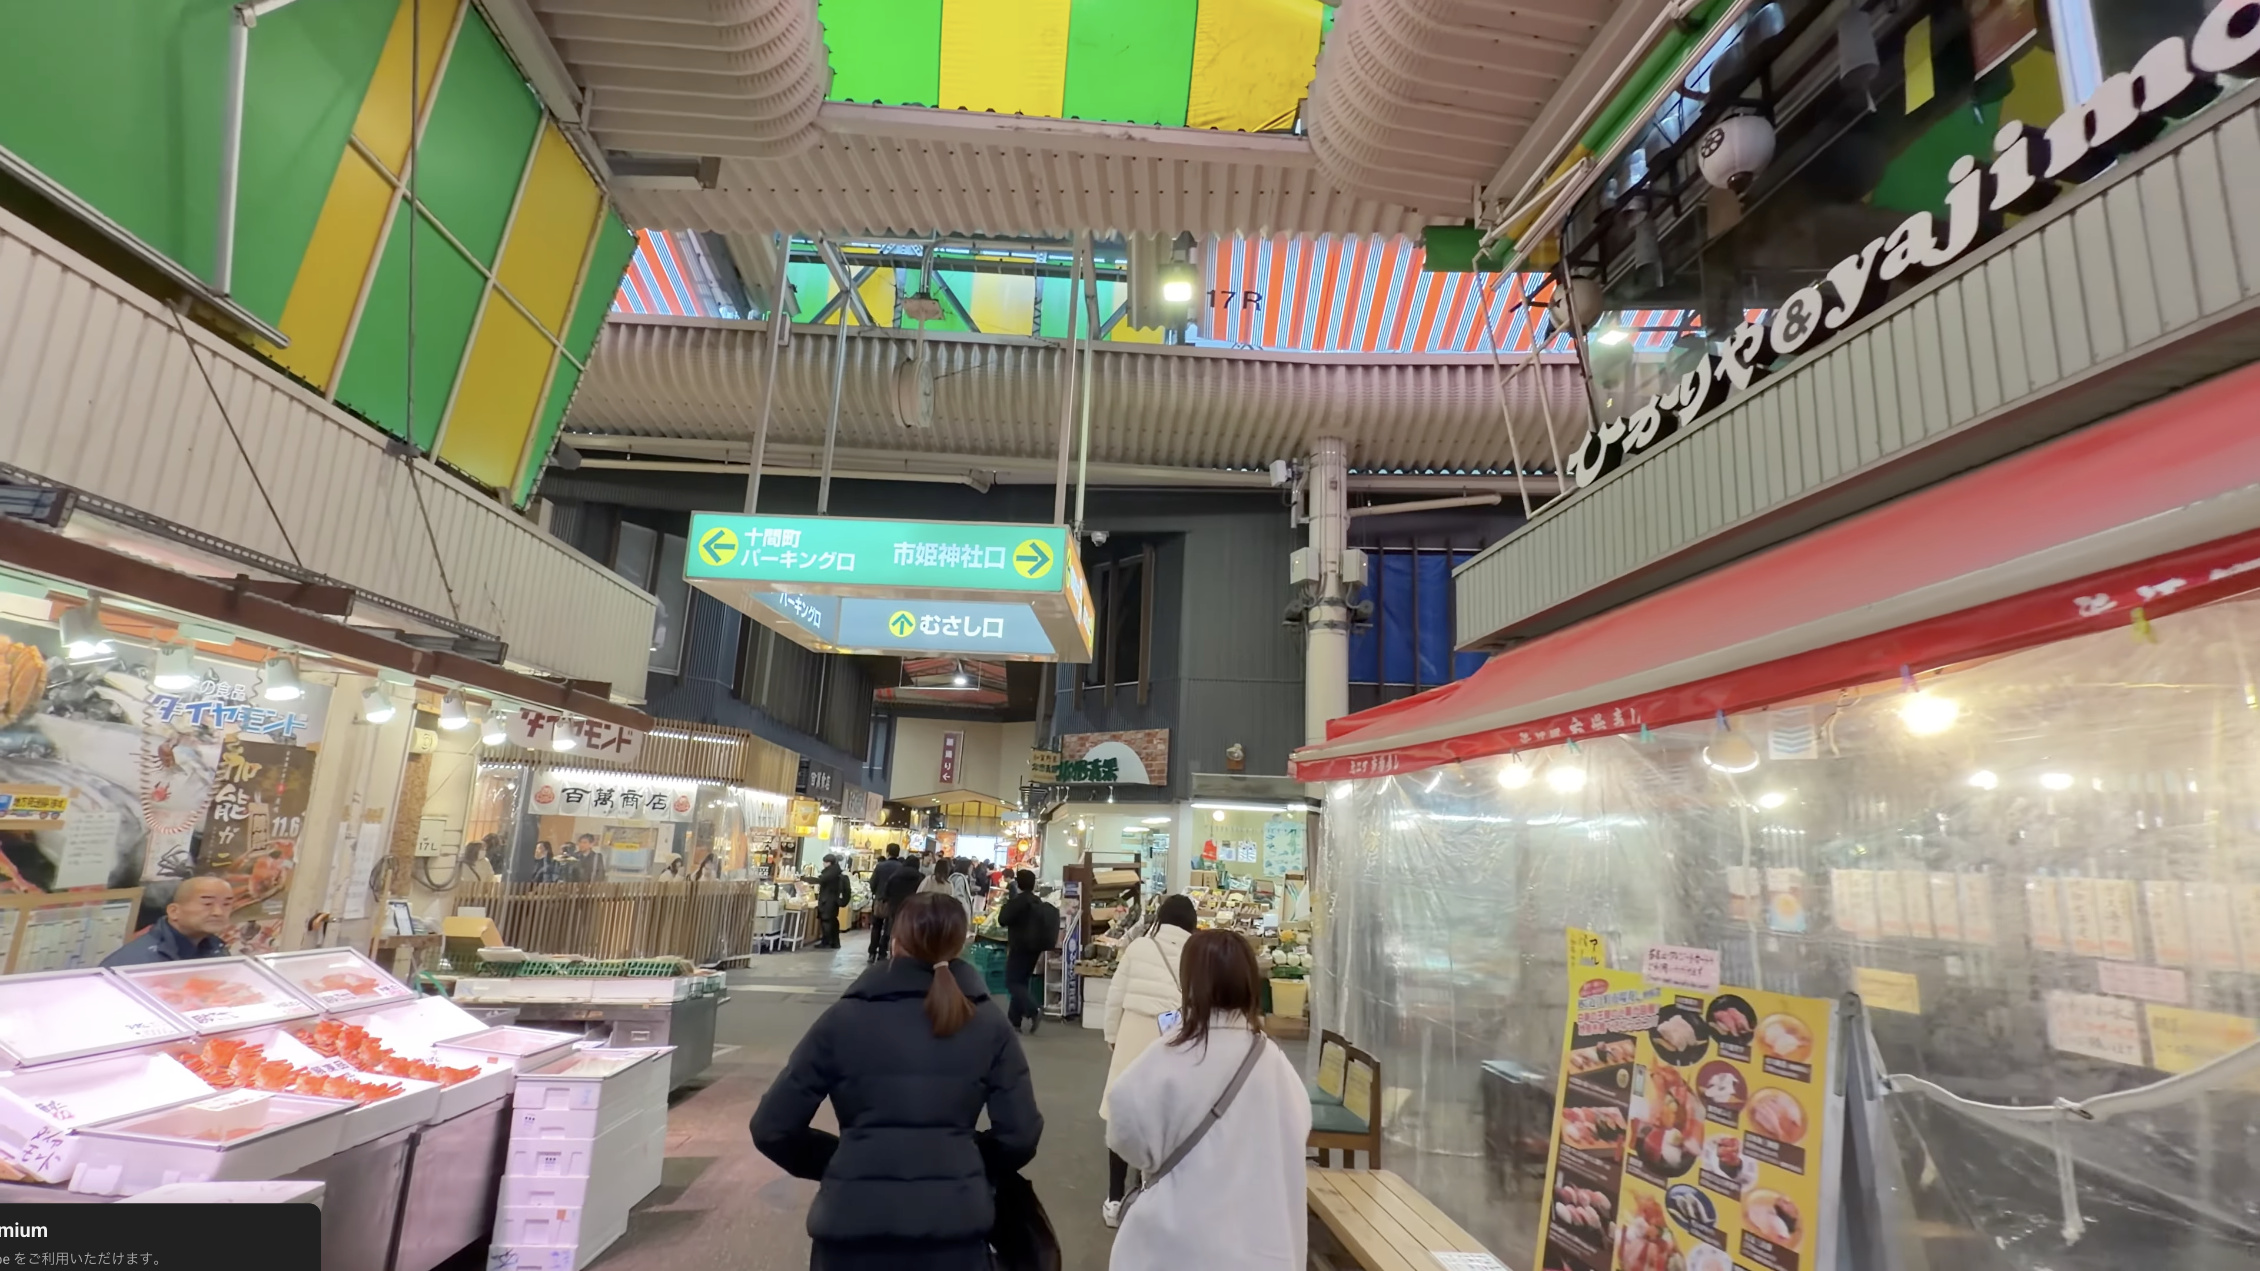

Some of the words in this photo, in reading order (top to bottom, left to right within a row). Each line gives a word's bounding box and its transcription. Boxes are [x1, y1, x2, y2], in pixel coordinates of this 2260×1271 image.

[1207, 289, 1263, 312] 17R
[744, 526, 802, 549] 十間町
[740, 549, 857, 573] パーキング口
[893, 541, 1006, 570] 市姫神社口
[919, 614, 1004, 639] むさし口
[150, 694, 309, 737] ダイヤモンド
[561, 787, 670, 811] 百萬商店
[418, 842, 438, 851] 17L
